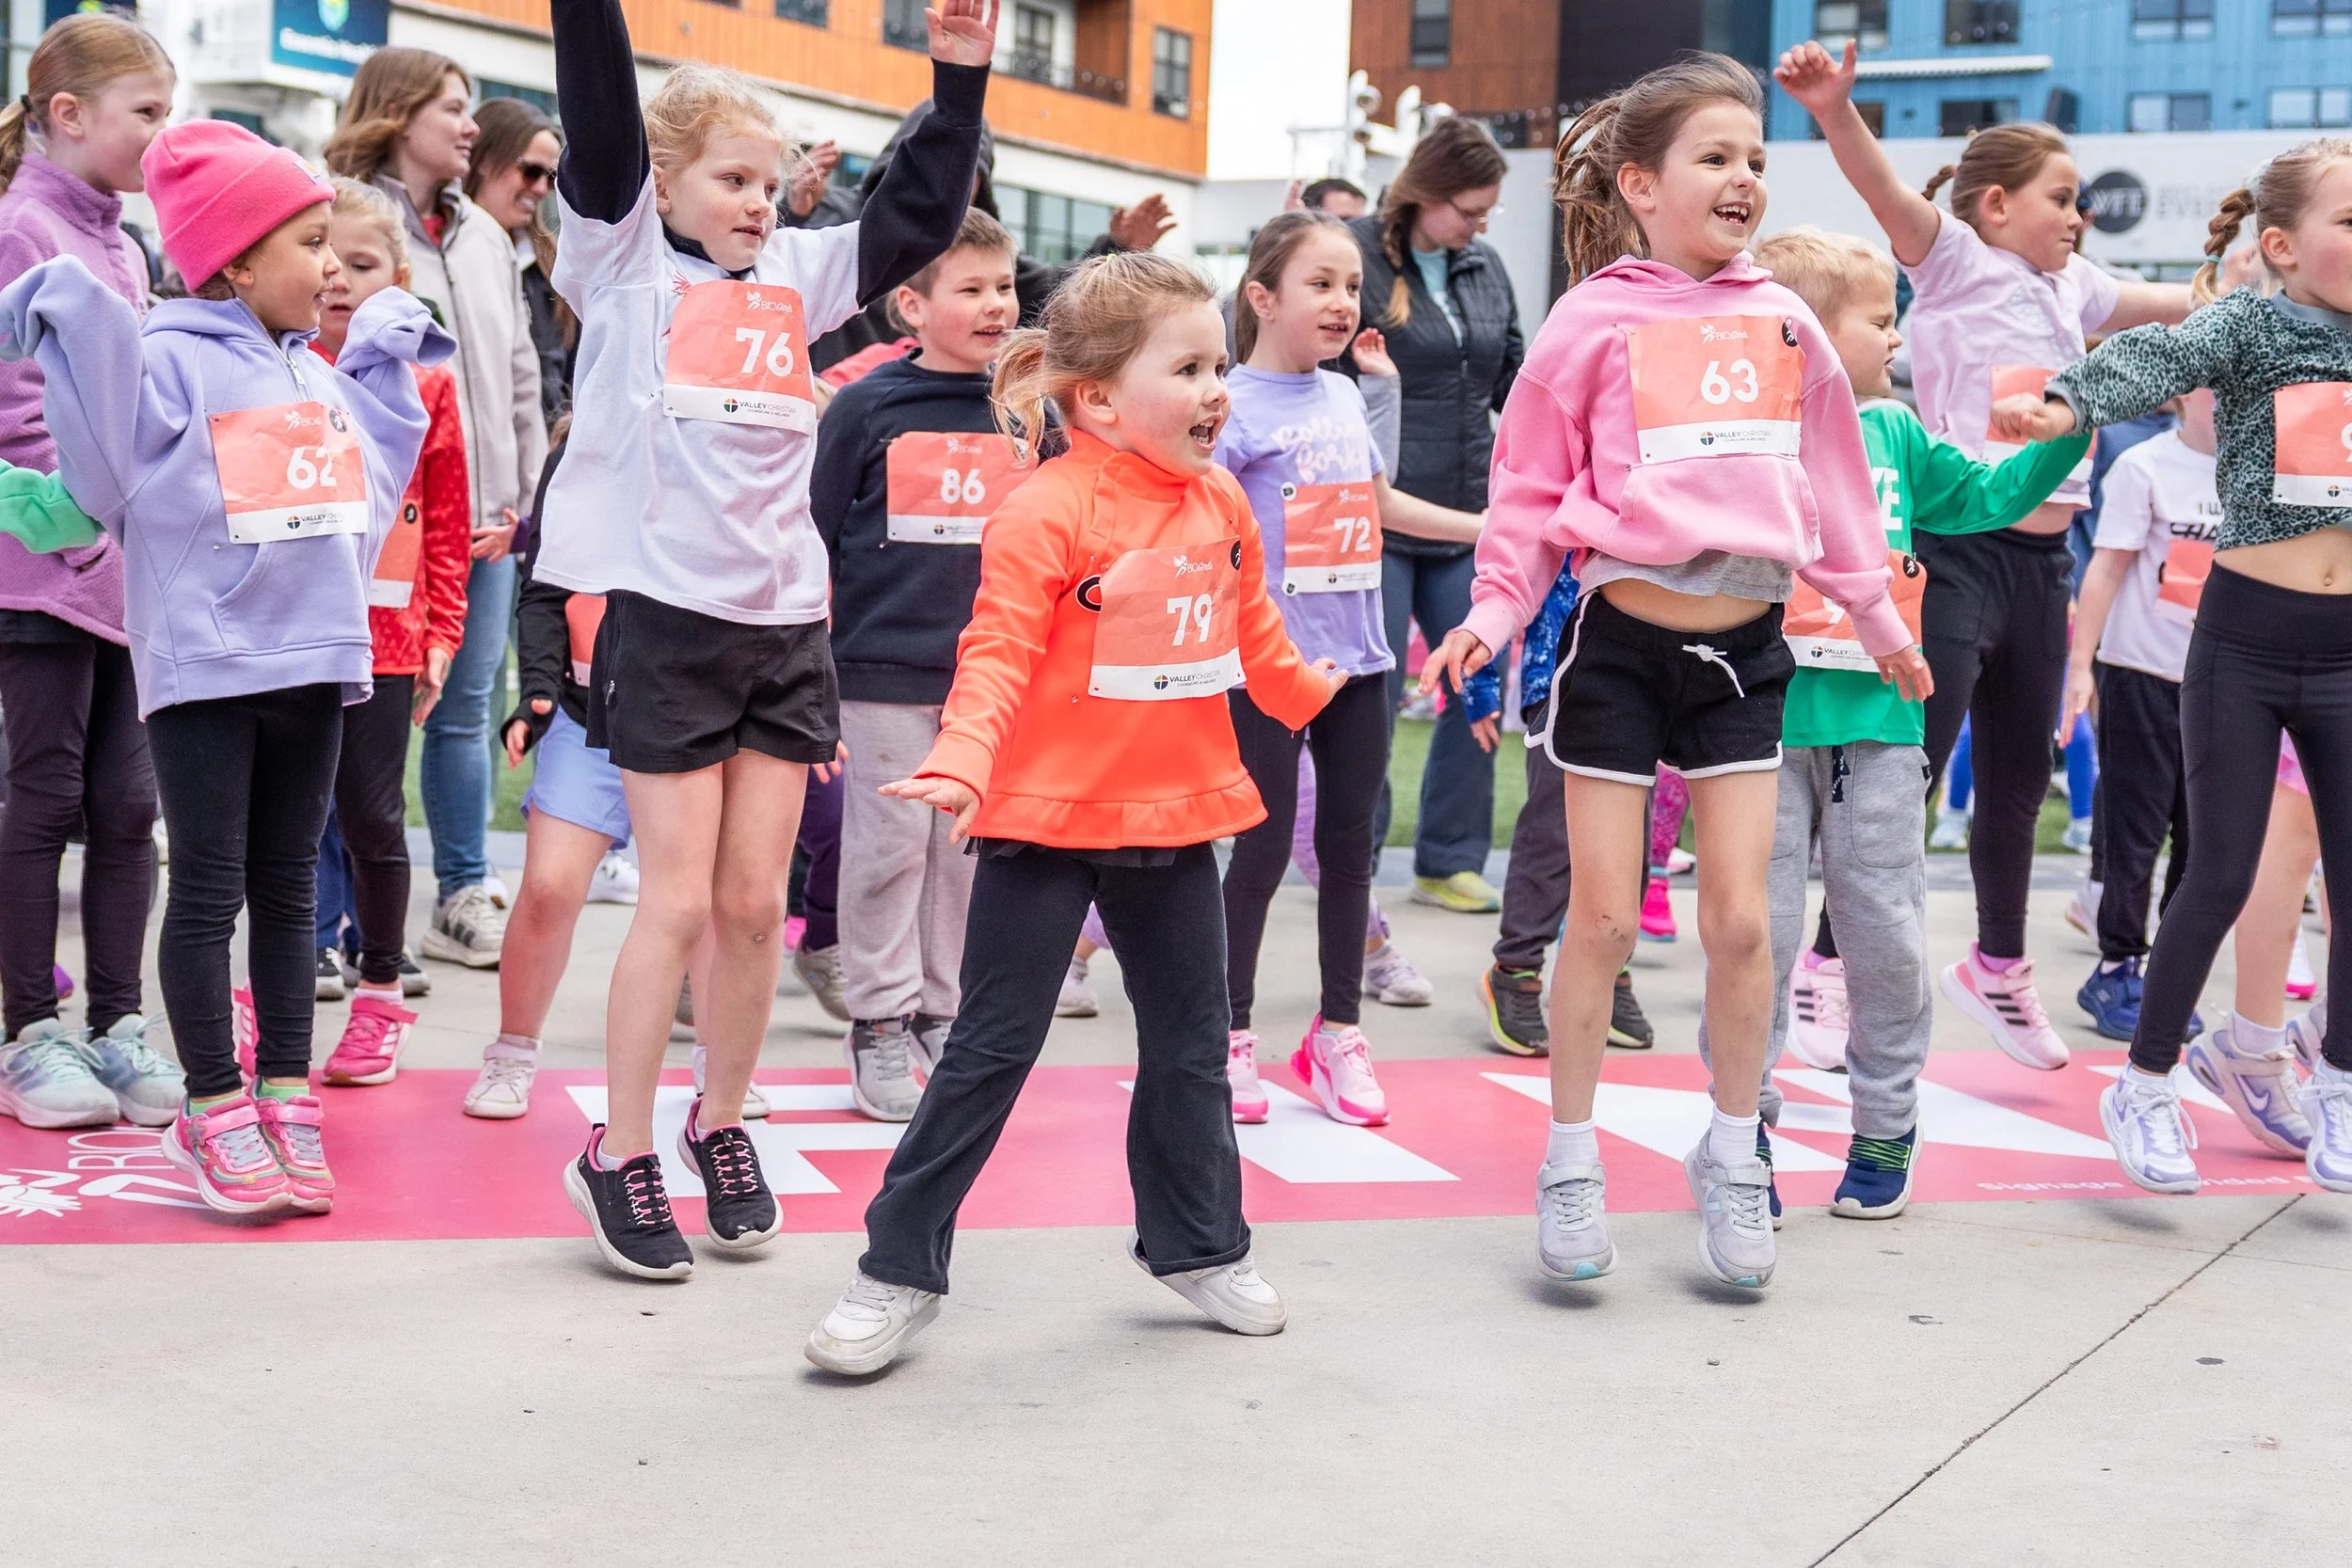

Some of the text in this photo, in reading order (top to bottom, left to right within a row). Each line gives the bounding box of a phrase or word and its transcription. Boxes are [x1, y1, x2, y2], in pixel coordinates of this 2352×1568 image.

[736, 327, 794, 377] 76
[1700, 358, 1759, 405] 63
[739, 401, 767, 409] VALLEY
[287, 447, 338, 490] 62
[941, 468, 986, 505] 86
[301, 514, 326, 522] VALLEY
[2208, 501, 2223, 515] W
[1334, 516, 1372, 554] 72
[2169, 522, 2218, 541] CHA
[1167, 594, 1213, 647] 79
[1169, 673, 1196, 683] VALLEY
